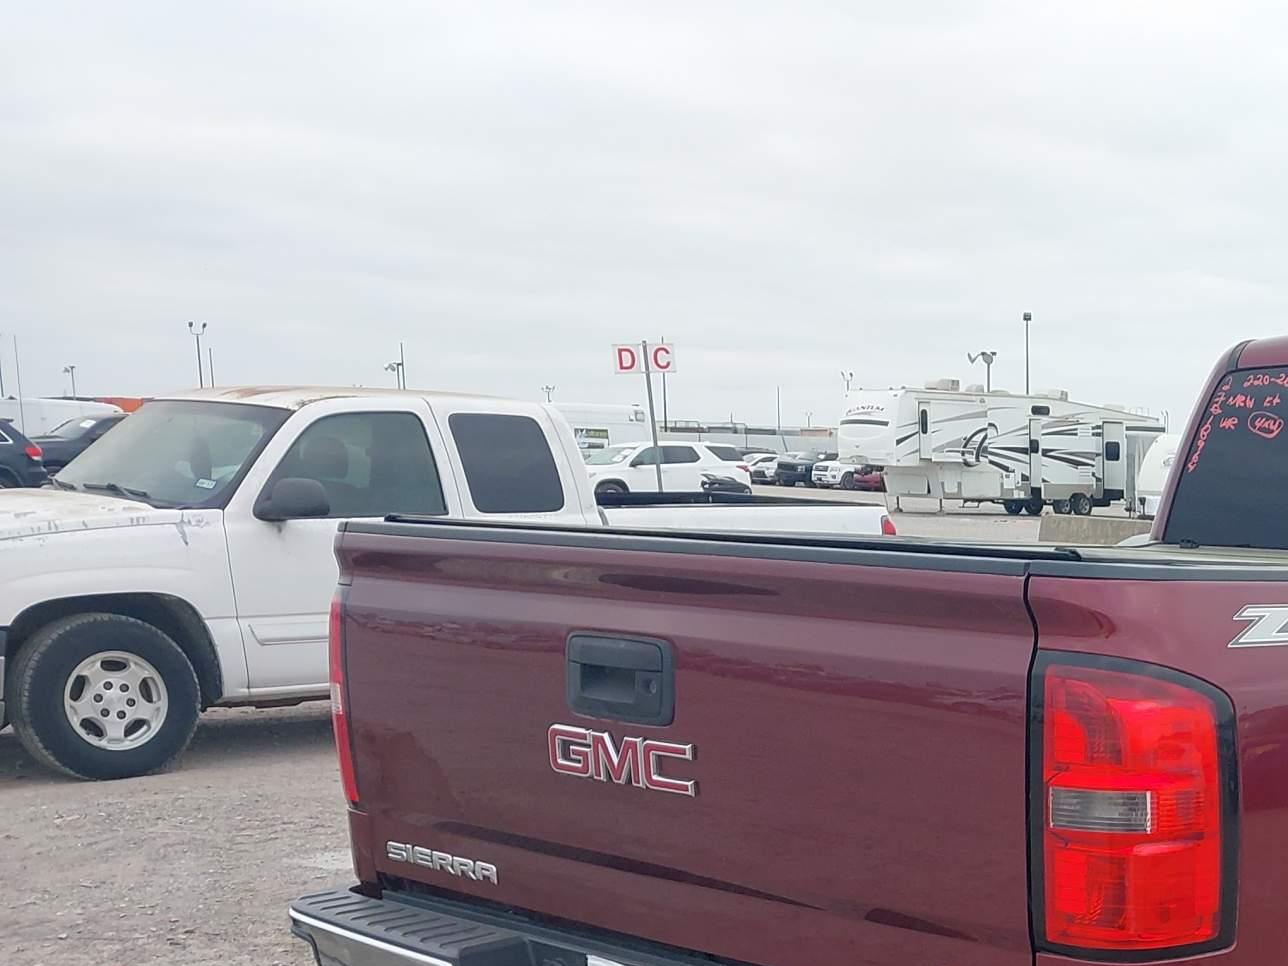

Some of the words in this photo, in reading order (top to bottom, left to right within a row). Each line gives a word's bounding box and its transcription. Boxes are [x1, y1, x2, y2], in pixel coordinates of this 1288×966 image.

[617, 347, 636, 370] D
[653, 346, 671, 370] C
[547, 723, 698, 798] GMC
[386, 839, 499, 886] SIERRA
